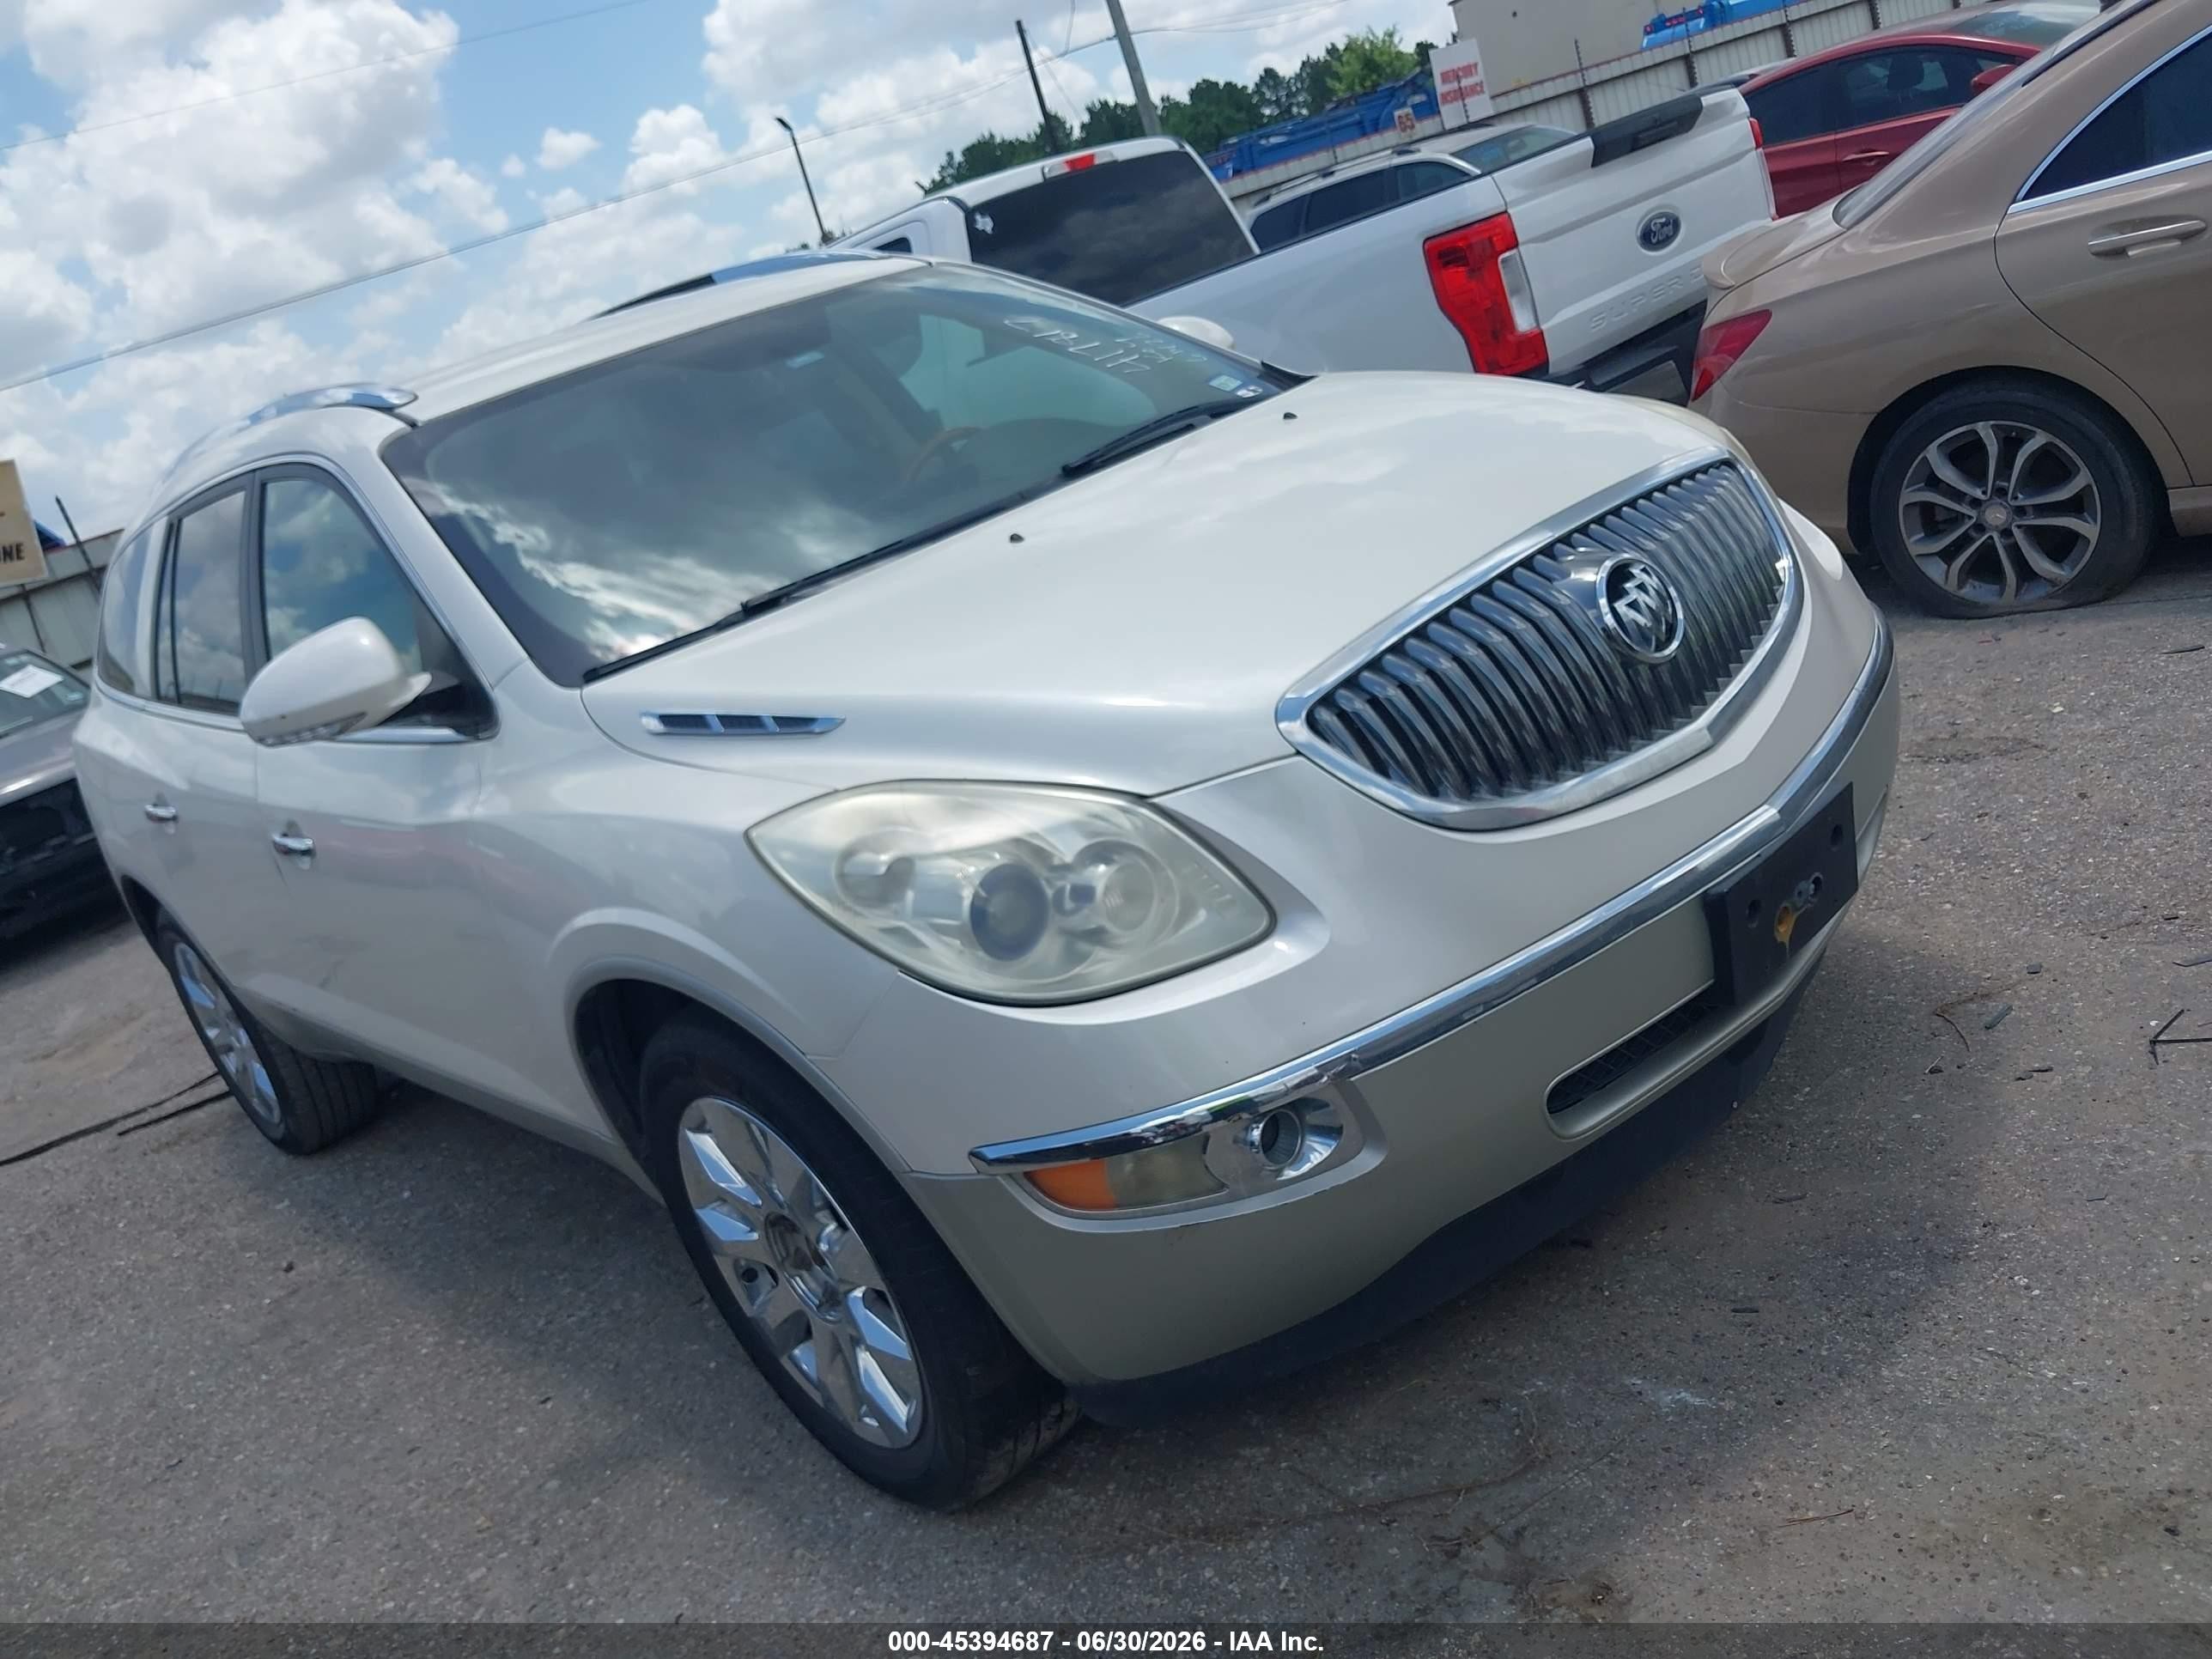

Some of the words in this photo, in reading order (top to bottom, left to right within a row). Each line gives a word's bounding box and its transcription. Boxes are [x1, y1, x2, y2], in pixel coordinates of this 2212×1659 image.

[1650, 216, 1674, 244] Ford
[1590, 276, 1684, 332] SUPER
[0, 542, 26, 563] NE
